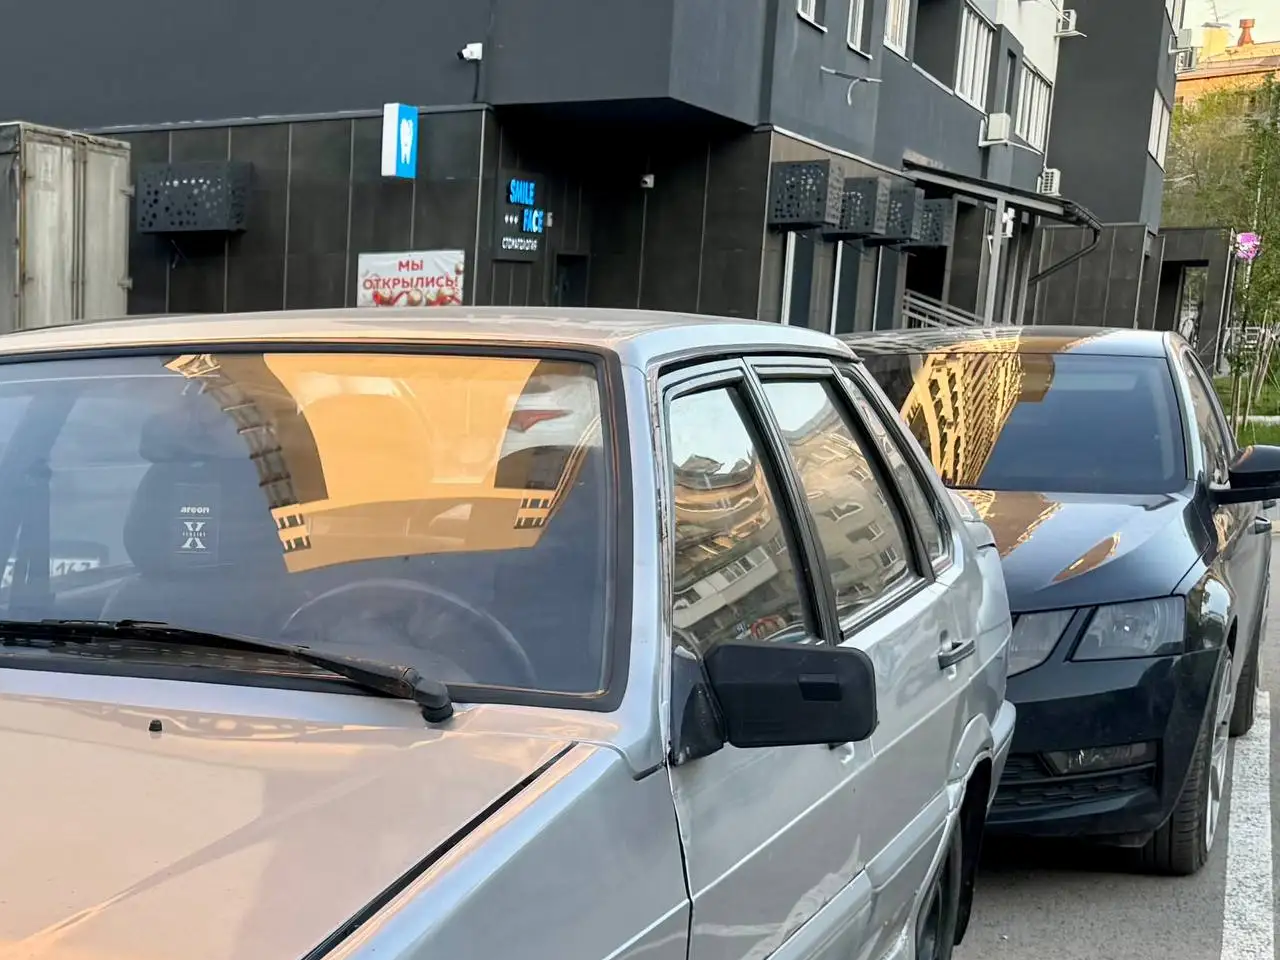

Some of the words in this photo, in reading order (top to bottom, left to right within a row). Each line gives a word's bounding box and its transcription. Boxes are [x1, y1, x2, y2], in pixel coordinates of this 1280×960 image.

[510, 179, 535, 205] SMILE
[523, 208, 544, 233] FACE
[398, 260, 424, 272] МЫ
[363, 276, 458, 290] ОТКРЫЛИСЬ!
